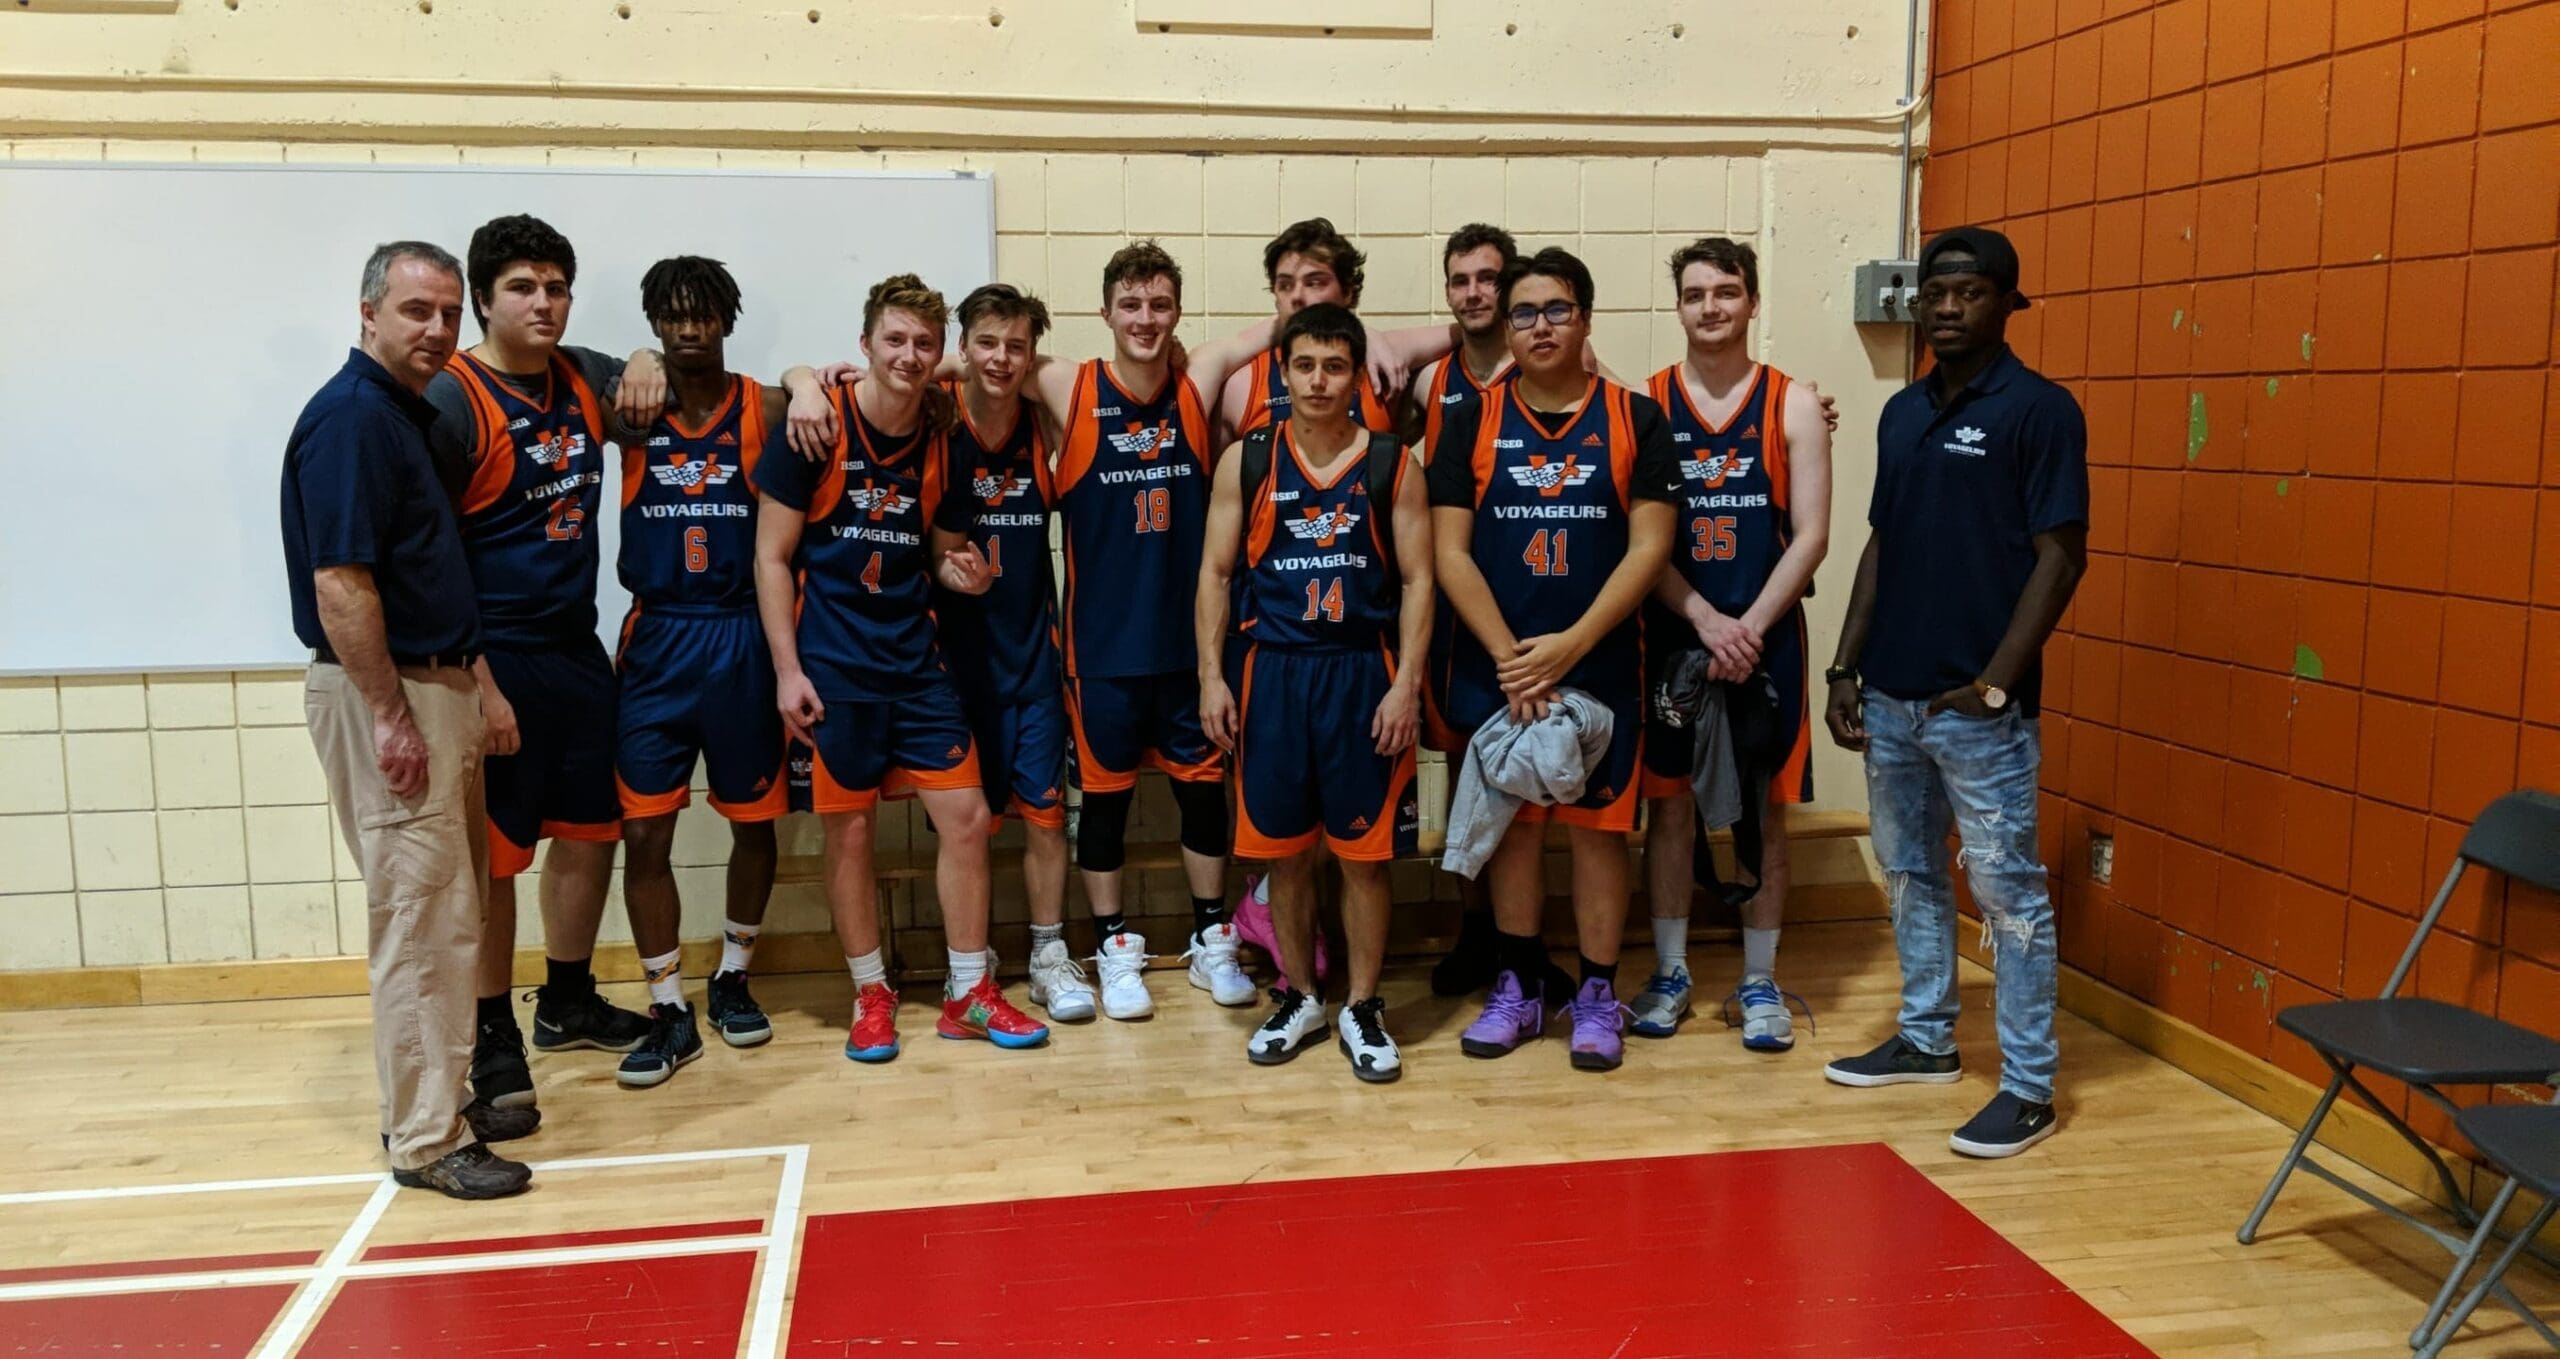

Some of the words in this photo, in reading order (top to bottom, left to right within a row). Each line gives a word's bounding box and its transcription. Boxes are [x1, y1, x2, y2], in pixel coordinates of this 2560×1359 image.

[1099, 464, 1191, 484] VOYAGEURS
[545, 495, 585, 541] 25
[640, 503, 749, 518] VOYAGEURS
[973, 514, 1044, 526] AGEURS
[1134, 487, 1171, 533] 18
[1493, 505, 1608, 519] VOYAGEURS
[1687, 494, 1768, 509] YAGEURS
[684, 526, 709, 572] 6
[831, 525, 920, 545] VOYAGEURS
[986, 534, 1003, 577] 1
[1523, 528, 1568, 575] 41
[1691, 516, 1737, 561] 35
[860, 551, 882, 594] 4
[1302, 576, 1344, 622] 14
